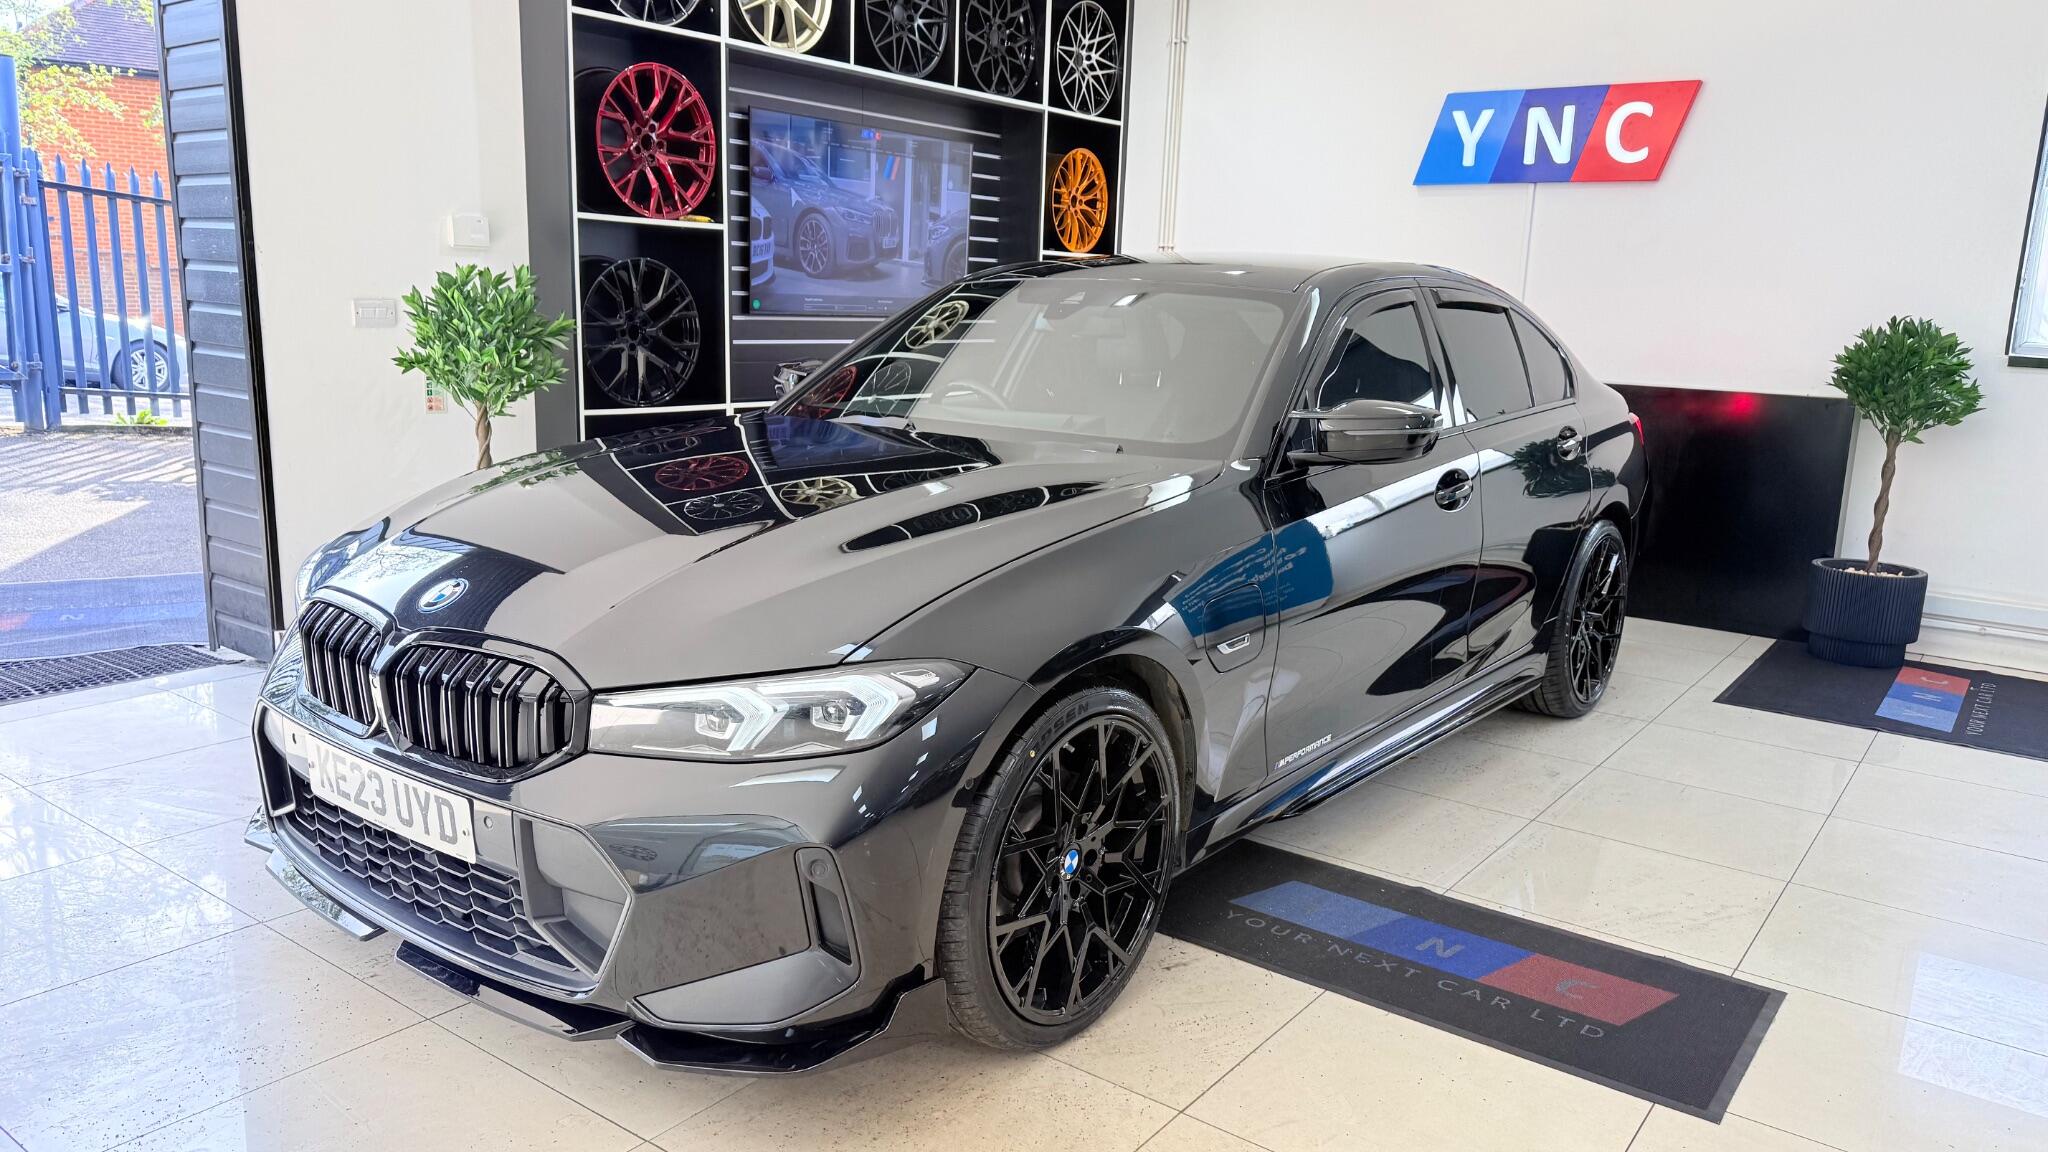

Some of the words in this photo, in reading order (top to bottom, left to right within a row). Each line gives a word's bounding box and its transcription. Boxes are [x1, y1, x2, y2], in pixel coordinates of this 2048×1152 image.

[1452, 101, 1654, 167] YNC
[317, 744, 387, 817] KE23
[391, 778, 458, 845] UYD
[1227, 910, 1313, 944] YOUR
[1327, 944, 1422, 978] NEXT
[1437, 979, 1511, 1010] CAR
[1530, 1008, 1605, 1039] LTD
